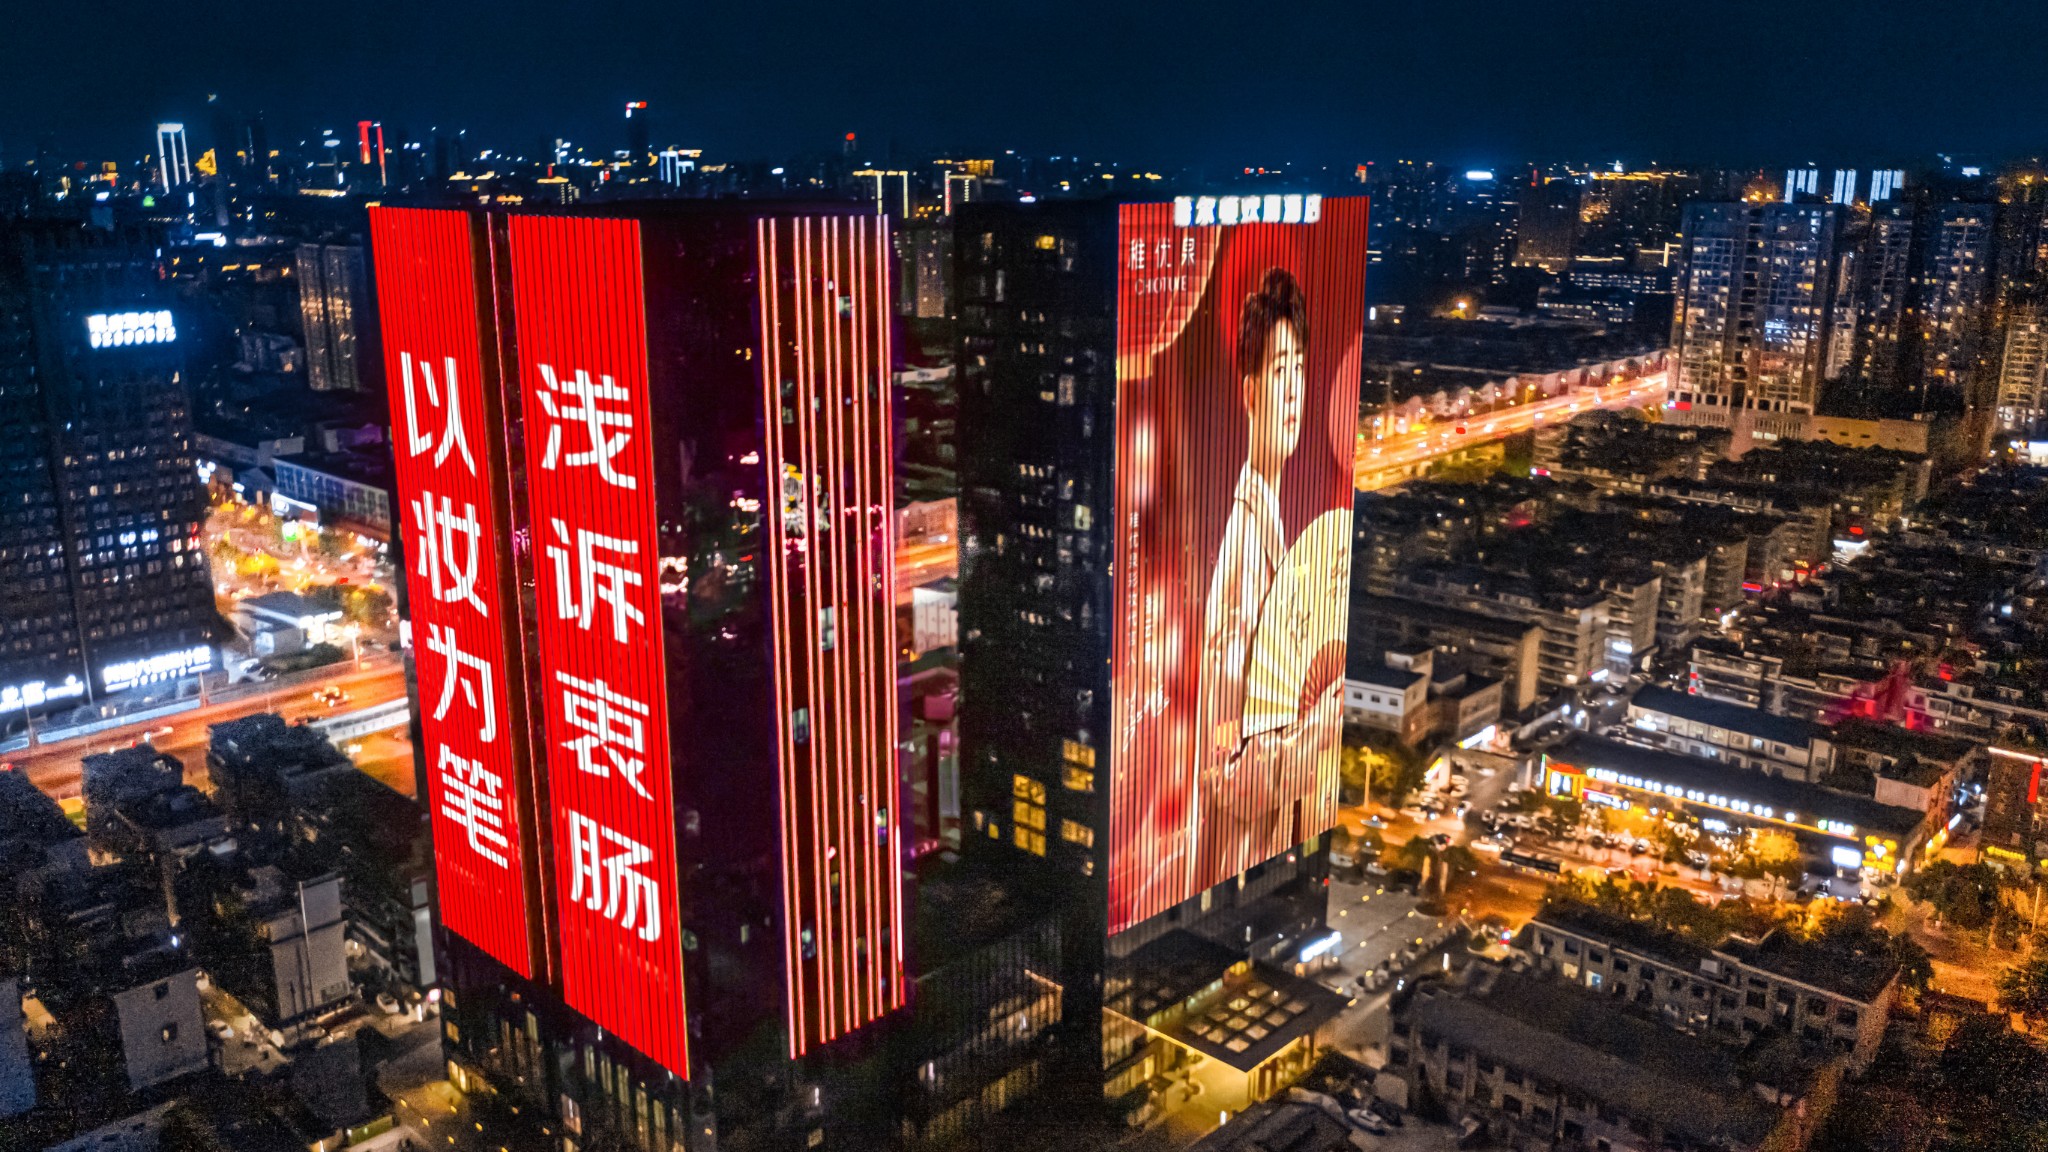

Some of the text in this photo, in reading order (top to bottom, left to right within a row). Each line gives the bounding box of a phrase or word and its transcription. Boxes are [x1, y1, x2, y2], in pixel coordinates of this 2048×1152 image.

[1128, 237, 1196, 270] 稚优泉
[400, 351, 508, 869] 以妆为笔
[536, 363, 661, 942] 浅诉衷肠
